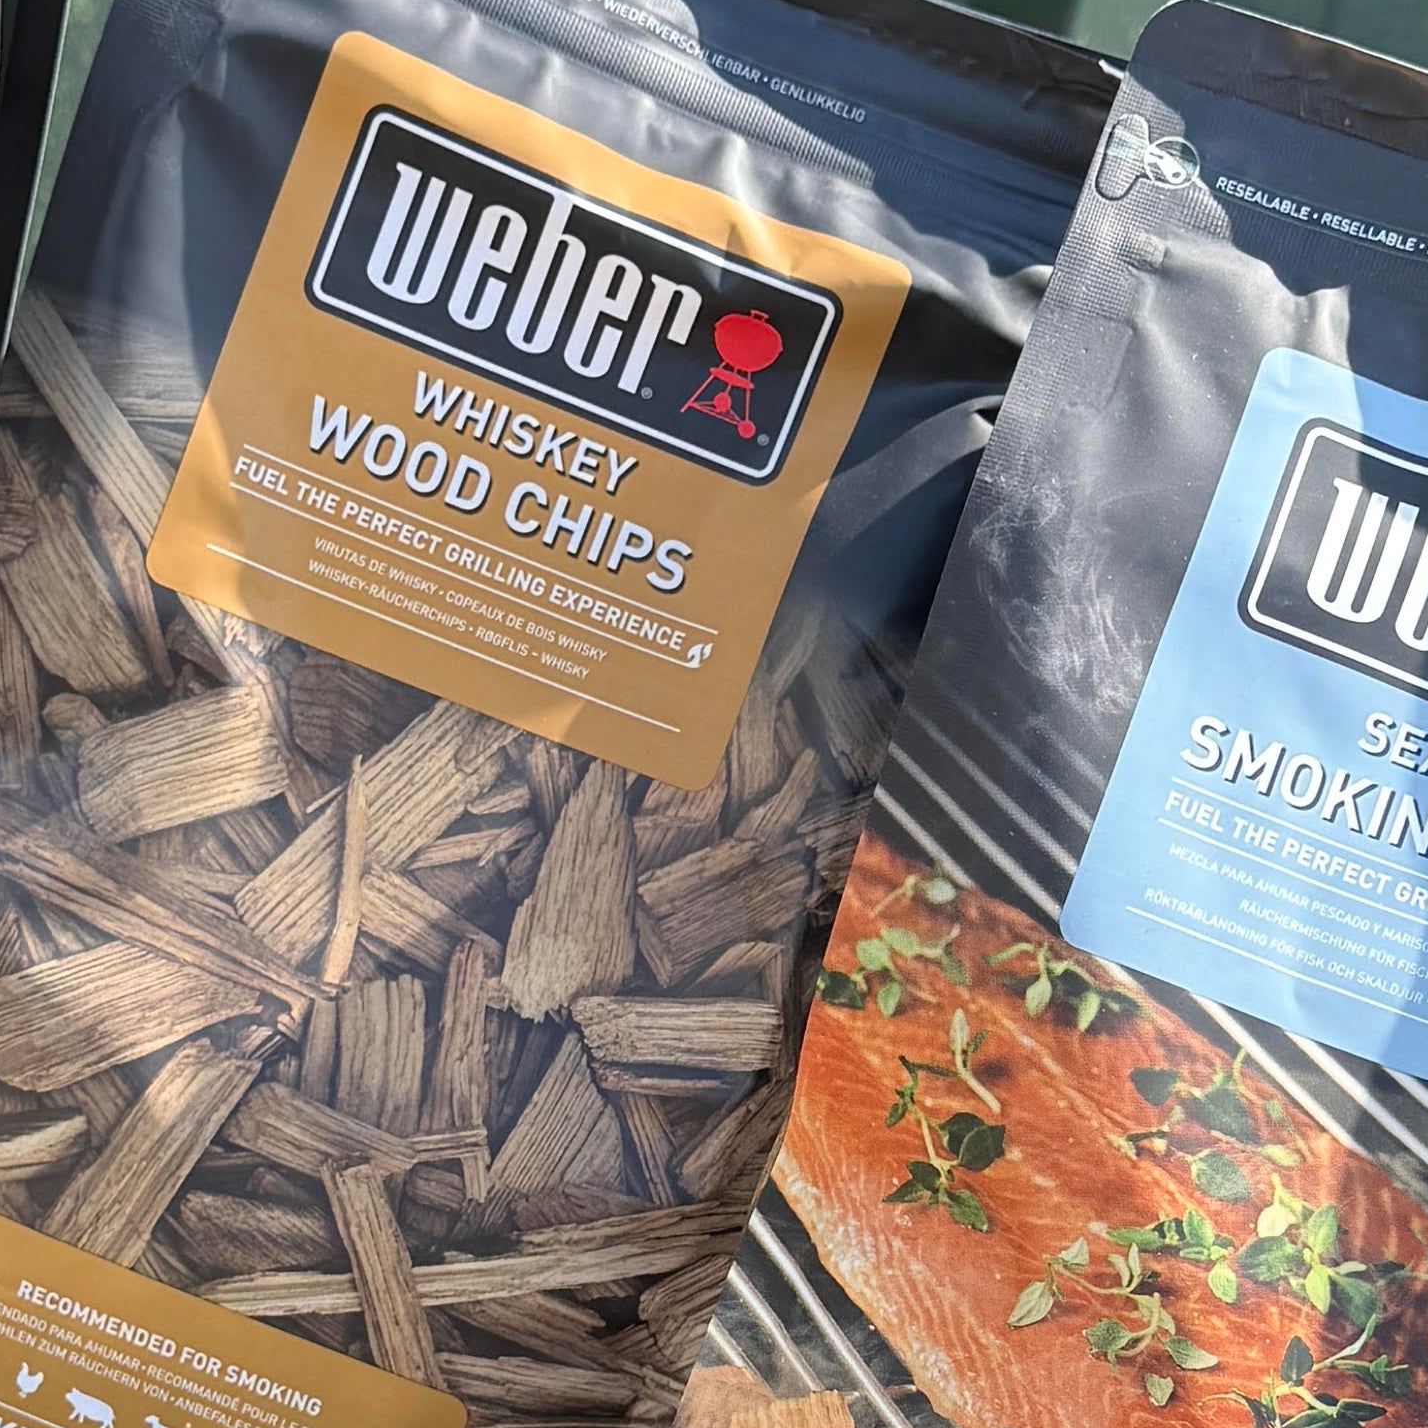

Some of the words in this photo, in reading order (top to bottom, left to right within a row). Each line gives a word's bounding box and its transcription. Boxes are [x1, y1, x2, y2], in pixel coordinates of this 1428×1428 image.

[769, 76, 865, 121] GENLUKKELIG
[1214, 176, 1311, 219] RESEALABLE
[1320, 211, 1416, 252] RESELLABLE
[366, 161, 703, 394] weber
[307, 394, 492, 513] WOOD
[503, 482, 693, 593] CHIPS
[413, 370, 637, 494] WHISKEY
[232, 455, 293, 494] FUEL
[292, 481, 339, 513] THE
[341, 500, 442, 555] PERFECT
[443, 540, 547, 598] GRILLING
[548, 583, 686, 649] EXPERIENCE
[313, 537, 367, 566] VIRUTAS
[367, 558, 385, 574] DE
[387, 566, 437, 595] WHISKY
[444, 590, 505, 621] COPEAUX
[505, 613, 524, 629] DE
[525, 621, 556, 641] BOIS
[556, 632, 606, 663] WHISKY
[307, 560, 468, 634] WHISKEY-RÄUCHERCHIPS
[475, 625, 529, 656] RØGFLIS
[539, 652, 589, 678] WHISKY
[1162, 790, 1227, 831] FUEL
[1227, 815, 1279, 852] THE
[1279, 837, 1390, 895] PERFECT
[15, 1281, 178, 1359] RECOMMENDED
[178, 1345, 223, 1377] FOR
[223, 1364, 322, 1415] SMOKING
